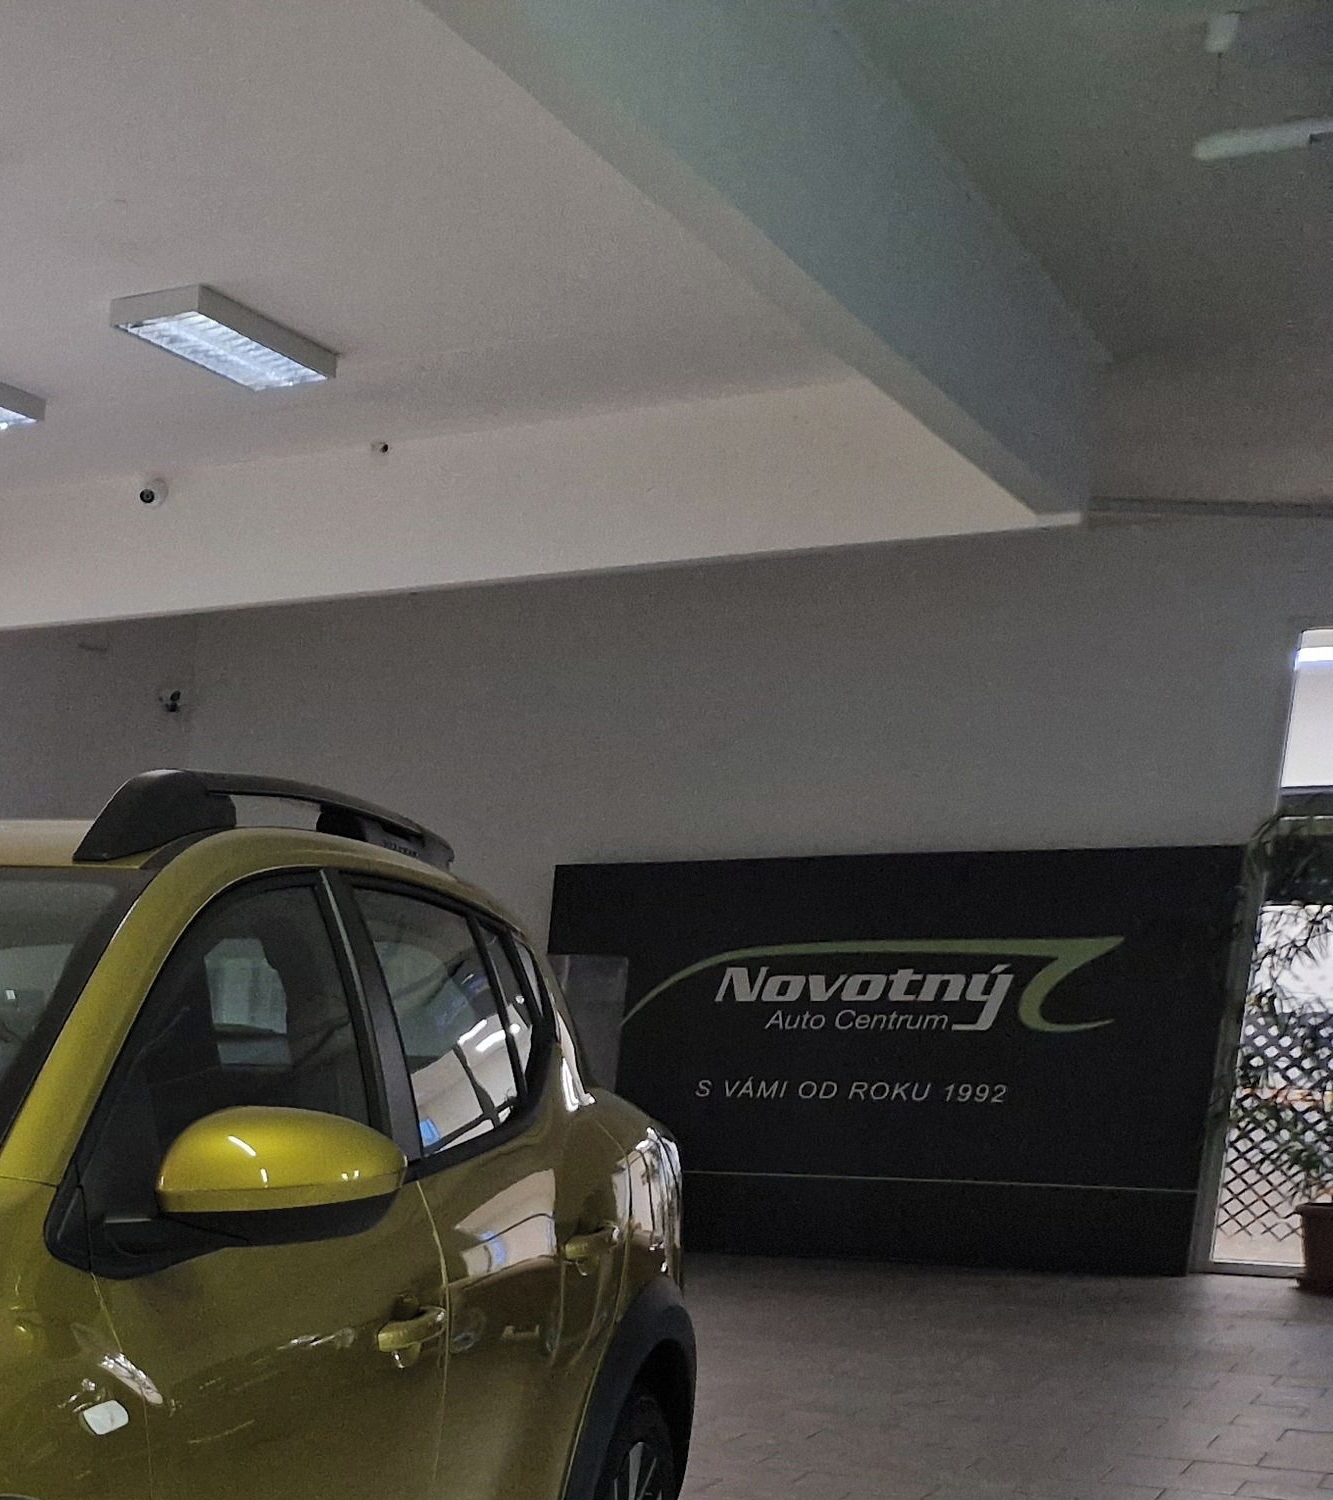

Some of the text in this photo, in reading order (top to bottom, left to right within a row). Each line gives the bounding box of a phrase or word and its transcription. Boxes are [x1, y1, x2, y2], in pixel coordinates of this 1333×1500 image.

[714, 963, 1015, 1031] Novotný
[764, 1009, 949, 1031] Auto Centrum
[694, 1076, 1008, 1104] S VÁMI OD ROKU 1992
